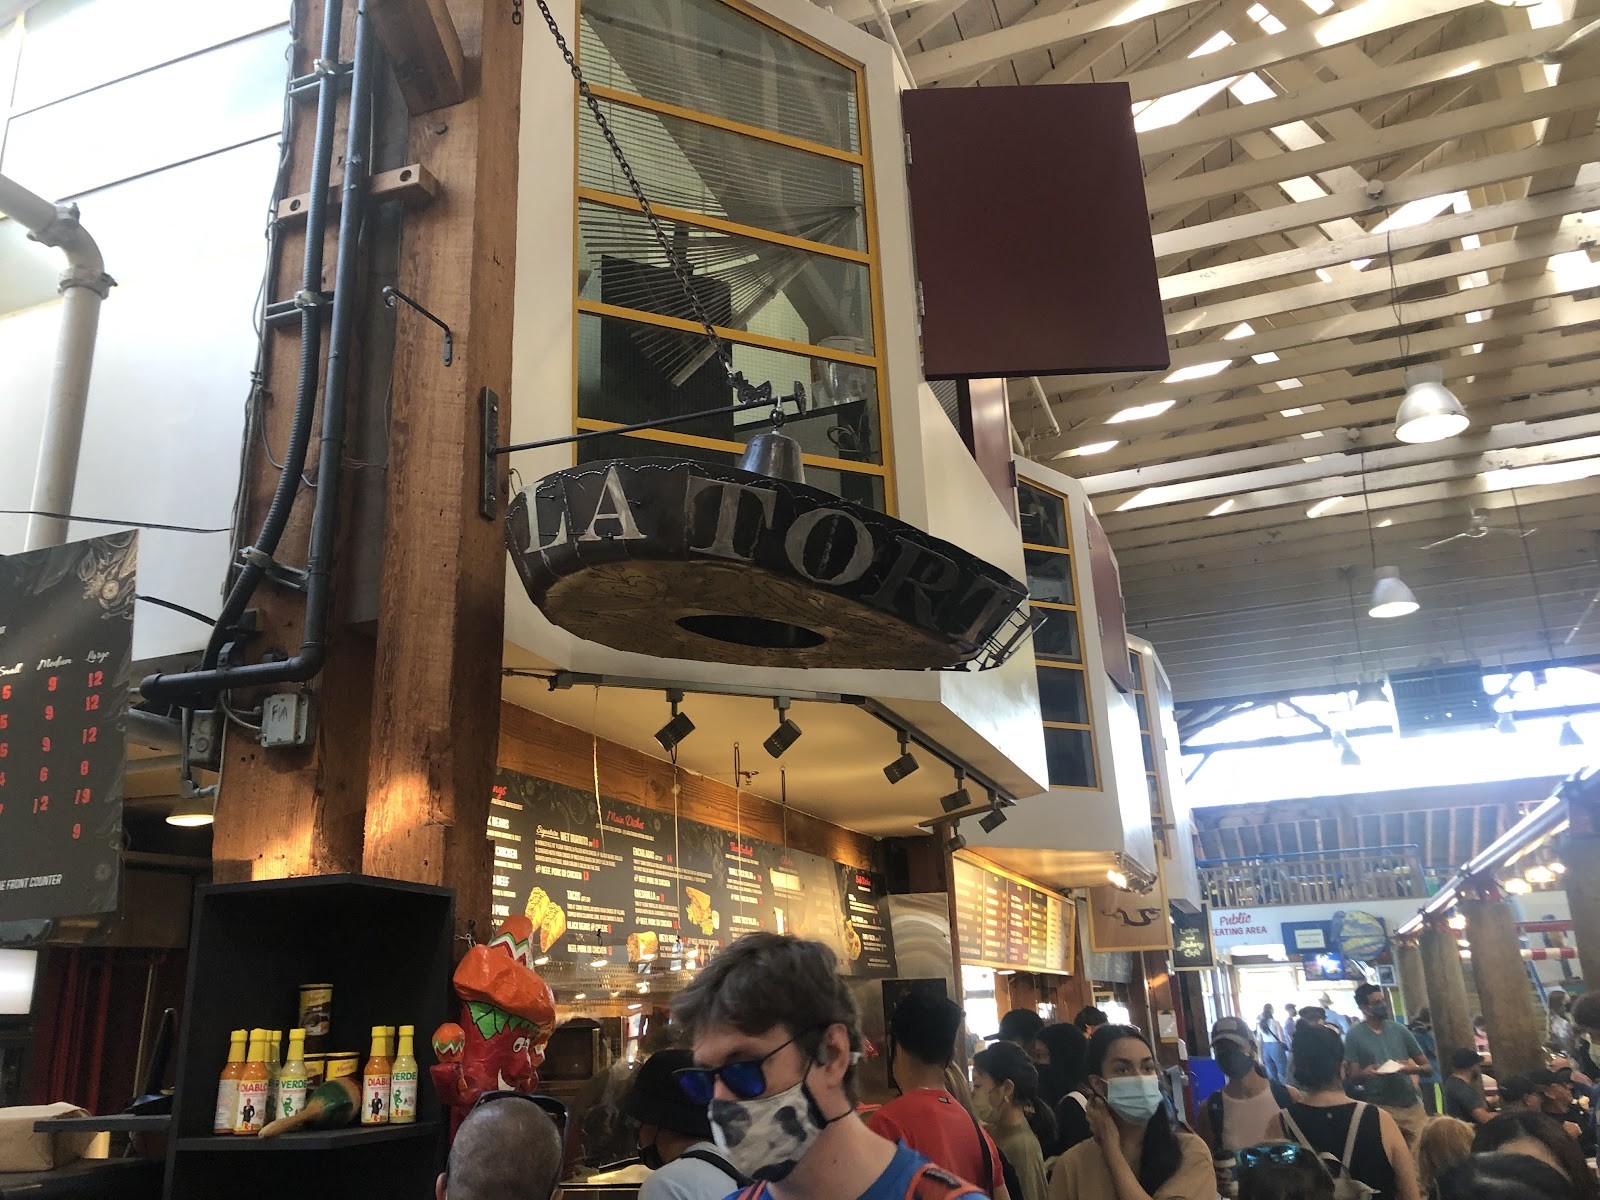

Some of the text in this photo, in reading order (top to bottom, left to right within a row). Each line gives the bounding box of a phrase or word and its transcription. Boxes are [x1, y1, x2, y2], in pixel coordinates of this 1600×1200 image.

[520, 466, 648, 554] LA
[48, 676, 57, 692] 9
[88, 671, 103, 688] 12
[45, 705, 54, 720] 9
[86, 695, 99, 711] 12
[42, 737, 50, 752] 9
[82, 727, 97, 744] 12
[32, 788, 91, 814] 12 19
[72, 823, 81, 839] 9
[6, 878, 29, 890] FRONT
[29, 874, 62, 888] COUNTER
[1219, 912, 1251, 926] Public
[1245, 926, 1268, 935] AREA
